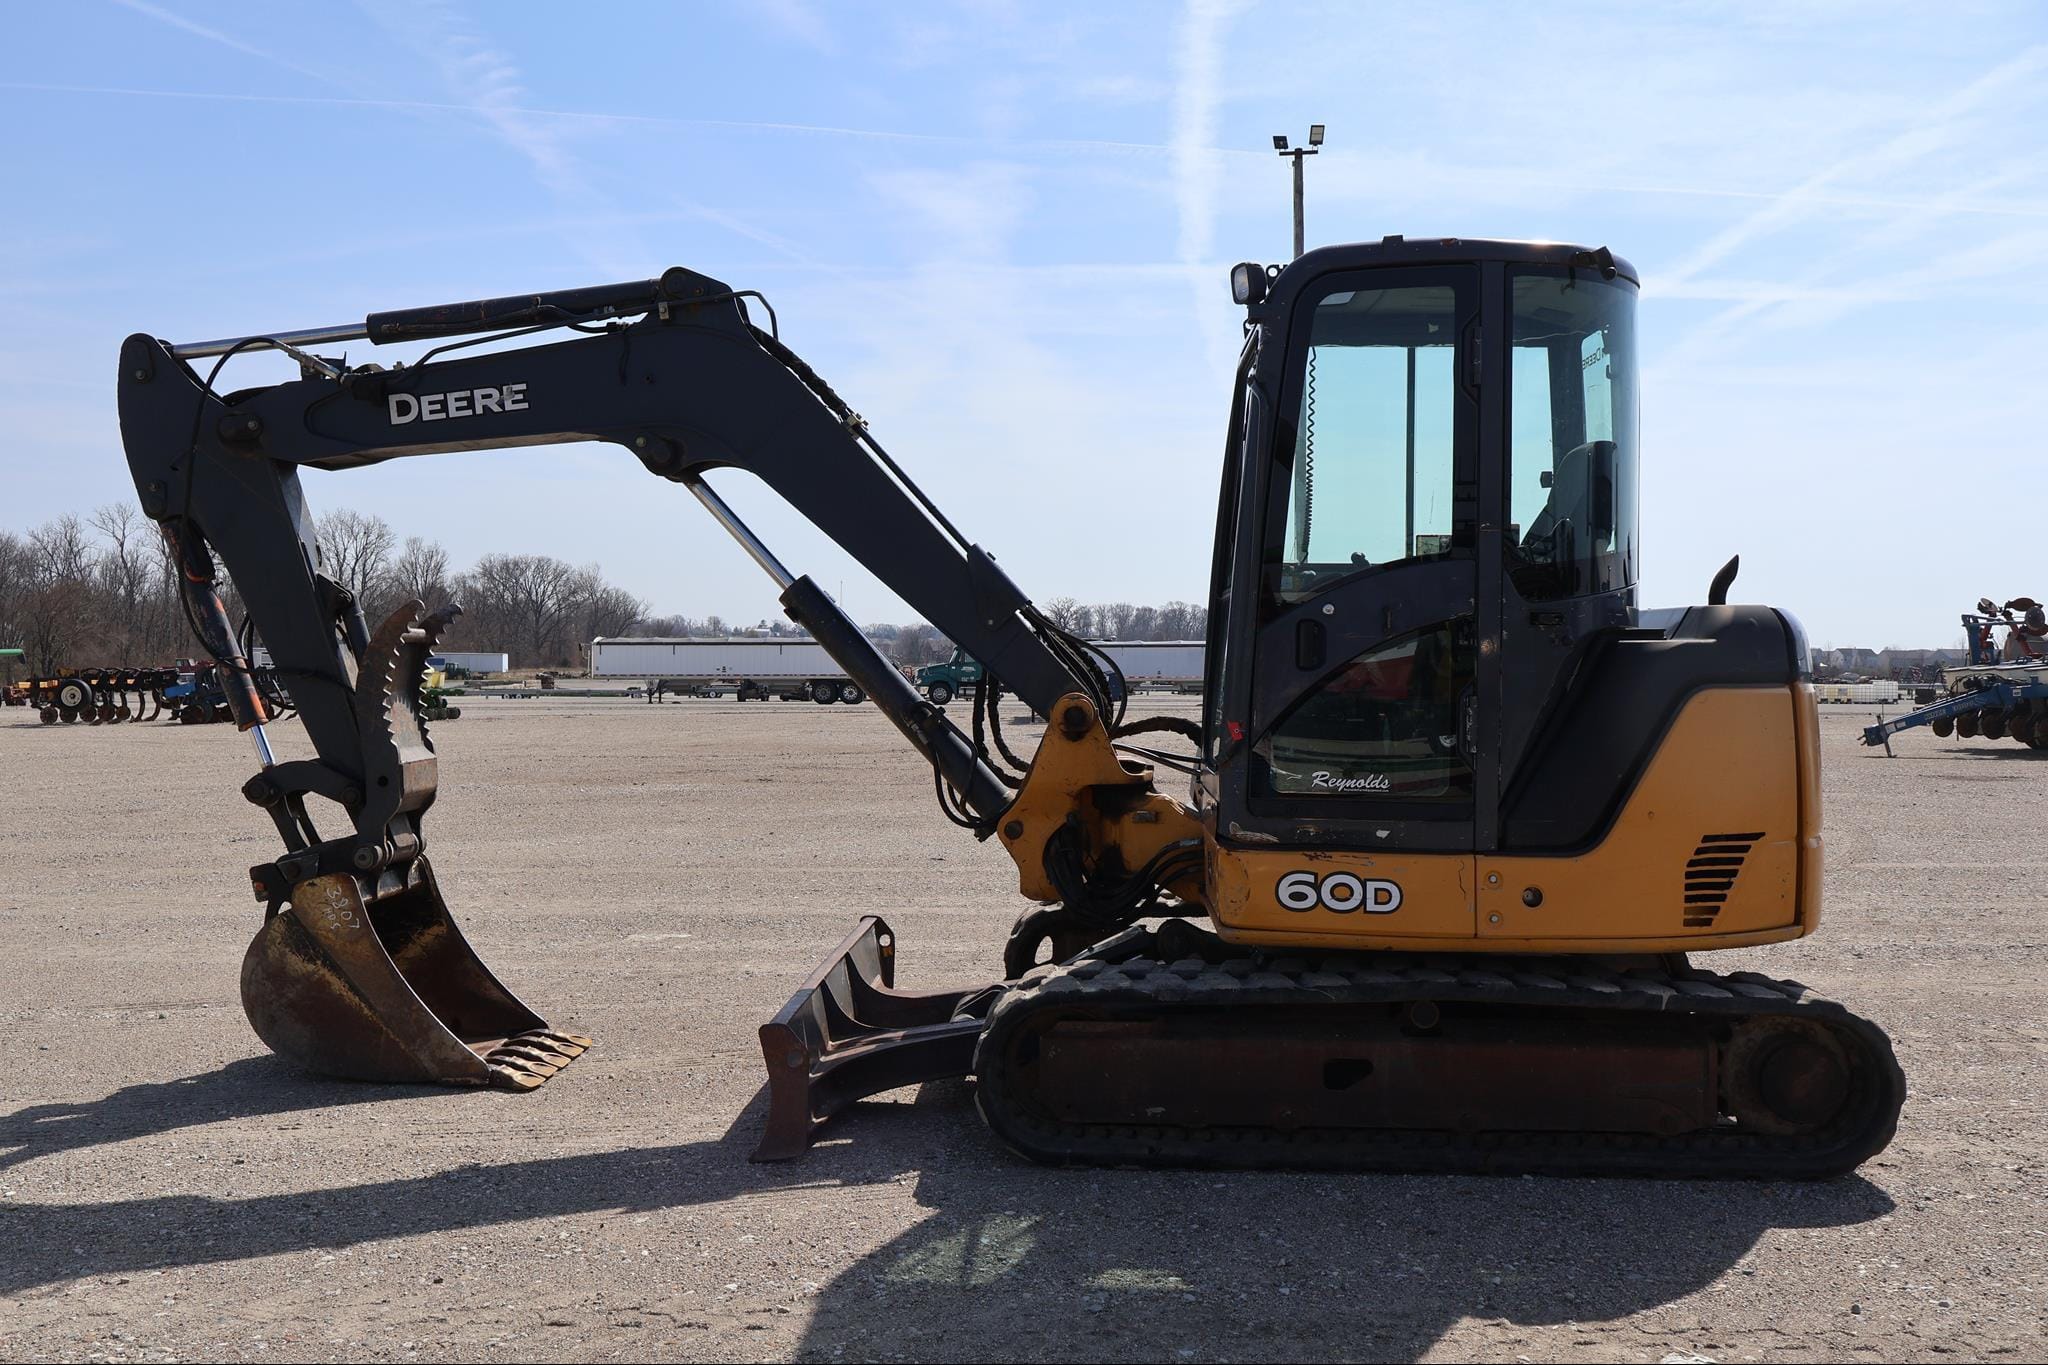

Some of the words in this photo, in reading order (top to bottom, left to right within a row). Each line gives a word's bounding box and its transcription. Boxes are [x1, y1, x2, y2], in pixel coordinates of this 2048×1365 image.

[388, 383, 529, 425] DEERE
[1311, 770, 1391, 792] Reynolds
[326, 885, 360, 929] 3807
[1276, 870, 1403, 914] 60D
